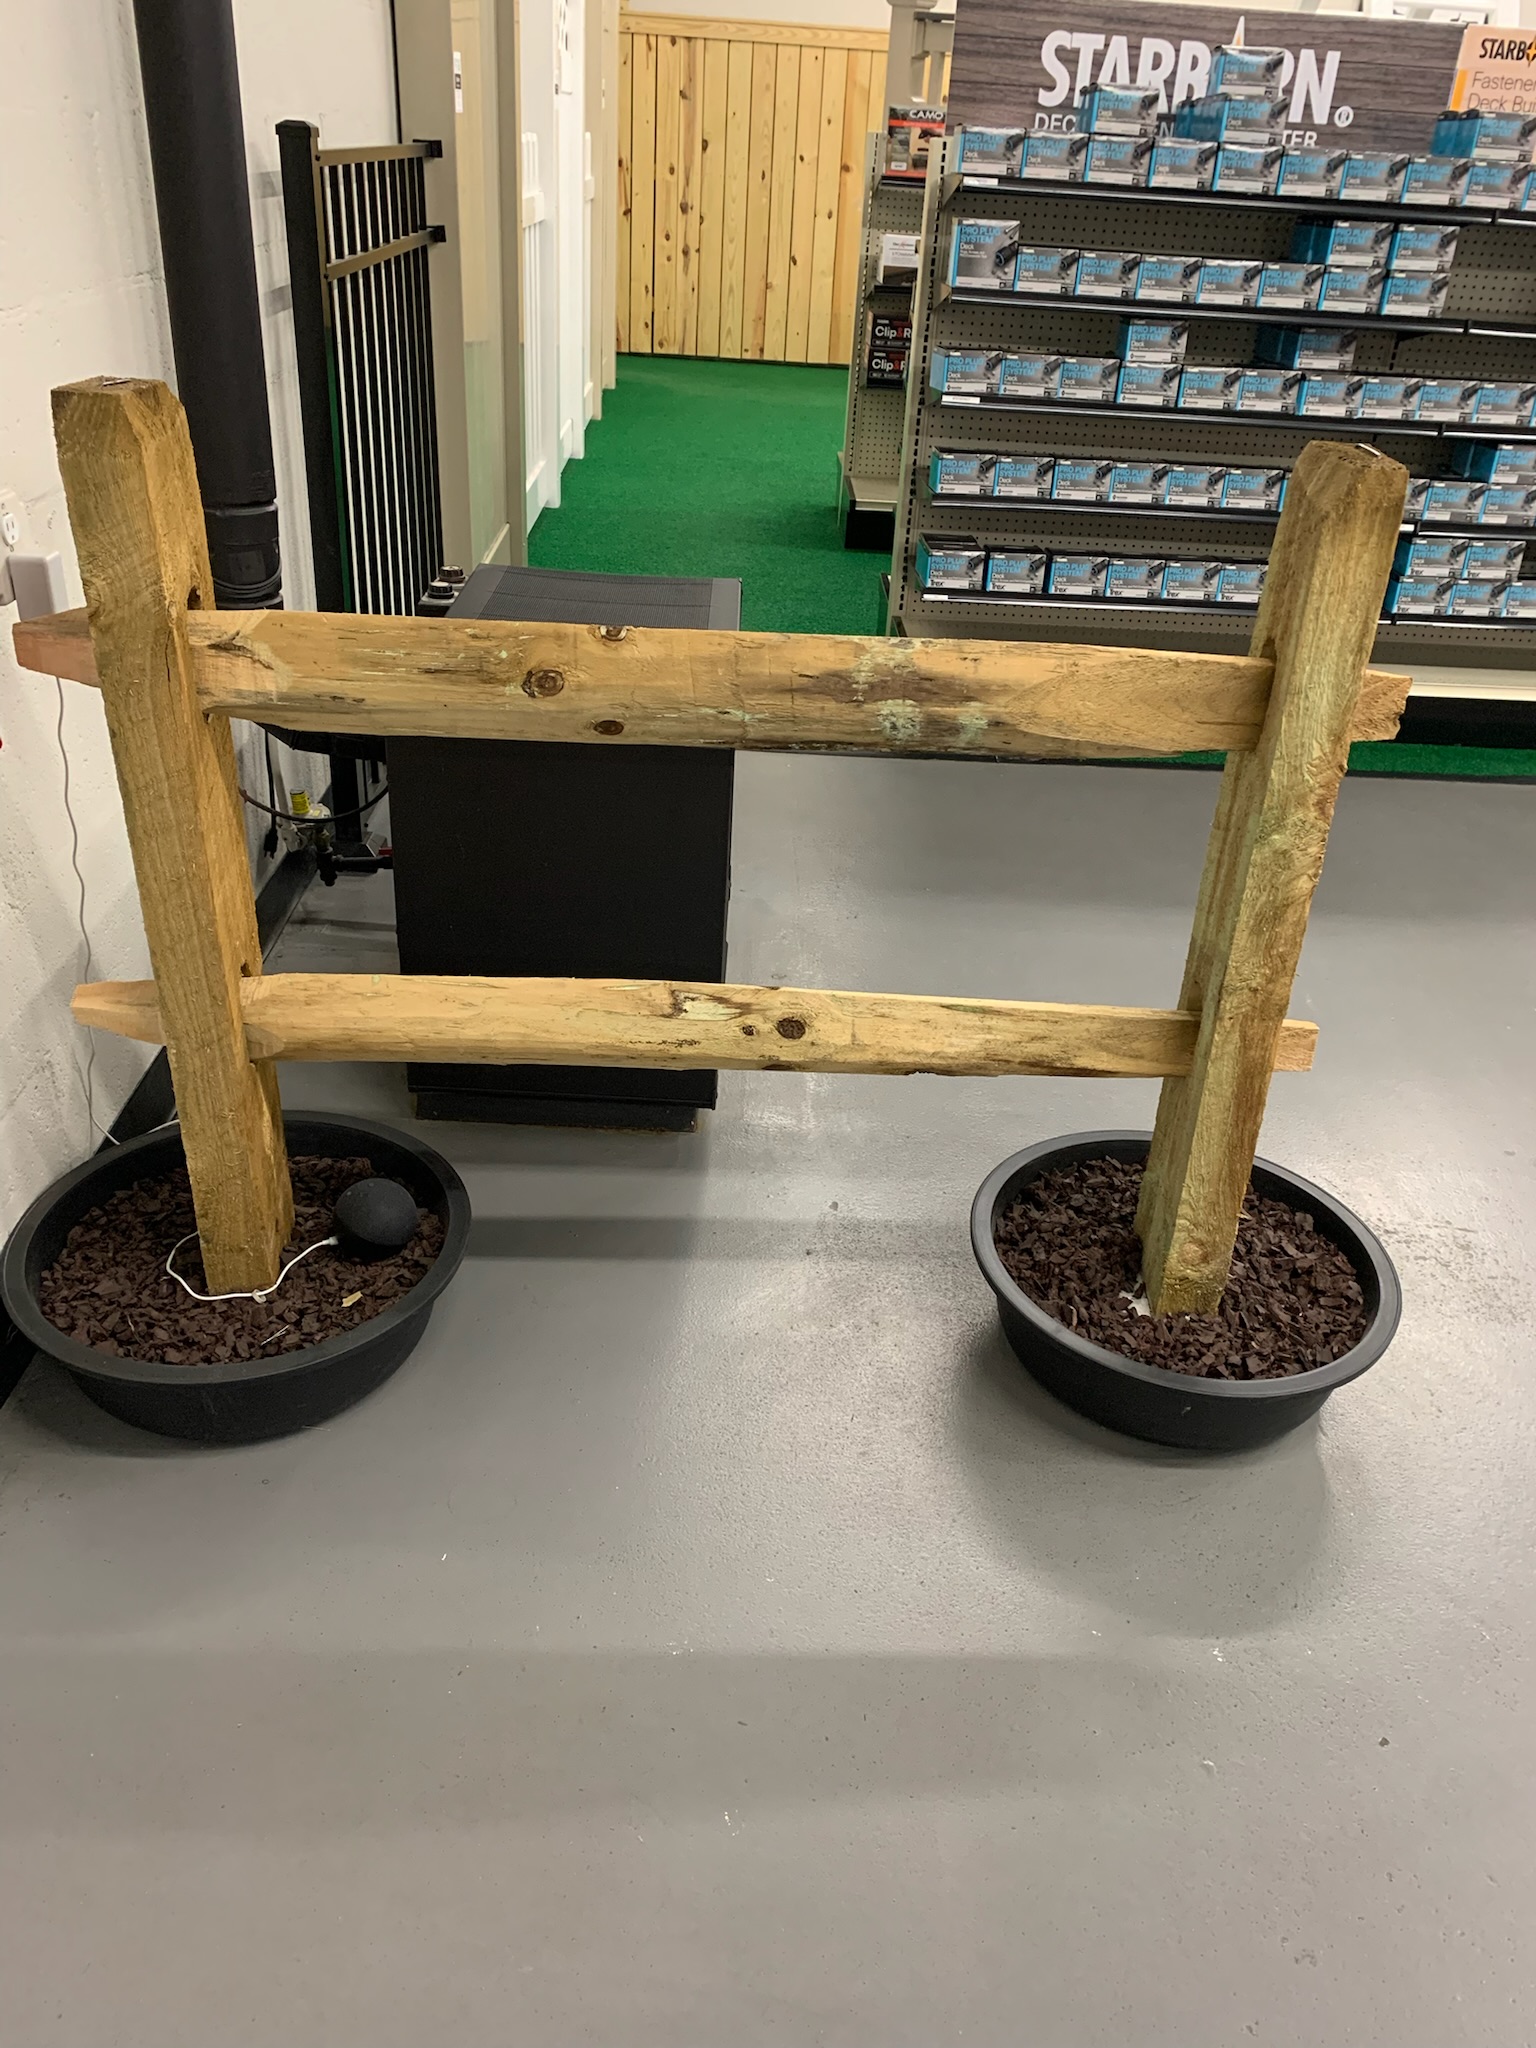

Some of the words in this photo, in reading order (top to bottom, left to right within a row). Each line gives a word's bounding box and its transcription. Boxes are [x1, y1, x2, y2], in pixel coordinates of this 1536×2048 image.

[1038, 30, 1341, 125] STARBN
[1468, 92, 1508, 111] Deck
[909, 109, 944, 120] CAMO
[1034, 112, 1076, 133] DEC
[965, 150, 979, 158] Deck
[961, 227, 977, 235] PRO
[961, 235, 994, 243] SYSTEM
[960, 242, 975, 250] Deck
[1021, 255, 1037, 263] PRO
[1000, 463, 1014, 471] PRO
